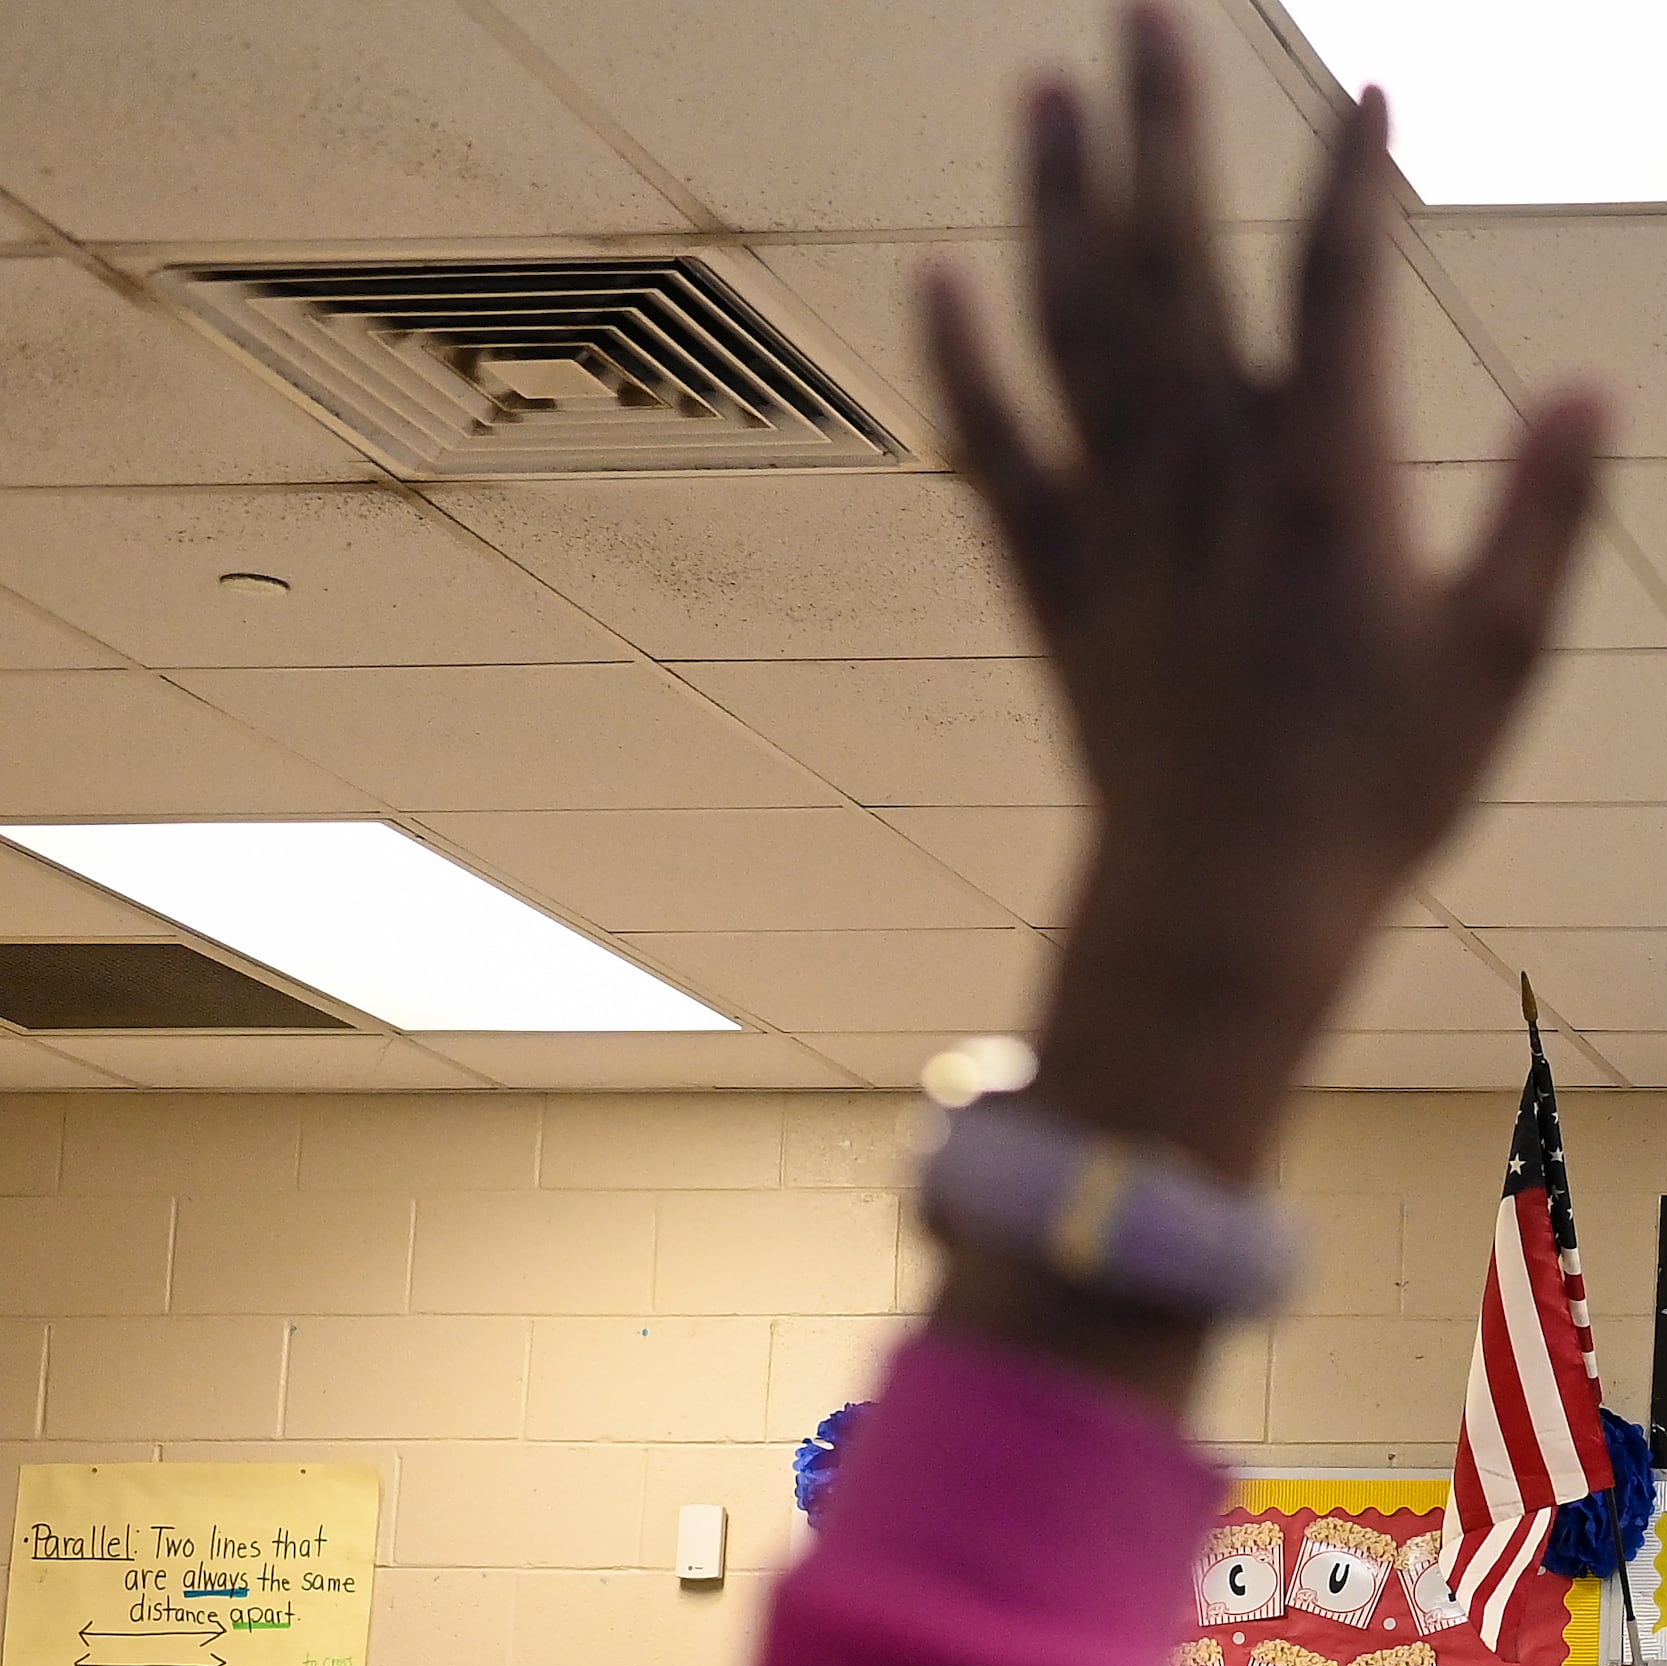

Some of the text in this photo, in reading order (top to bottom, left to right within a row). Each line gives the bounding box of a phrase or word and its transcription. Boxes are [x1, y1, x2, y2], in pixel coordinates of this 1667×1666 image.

[32, 1524, 328, 1560] Parallel: Two lines that
[125, 1561, 356, 1596] are always the same
[1229, 1564, 1245, 1596] C
[1327, 1563, 1350, 1594] U
[130, 1595, 302, 1632] distance apart.
